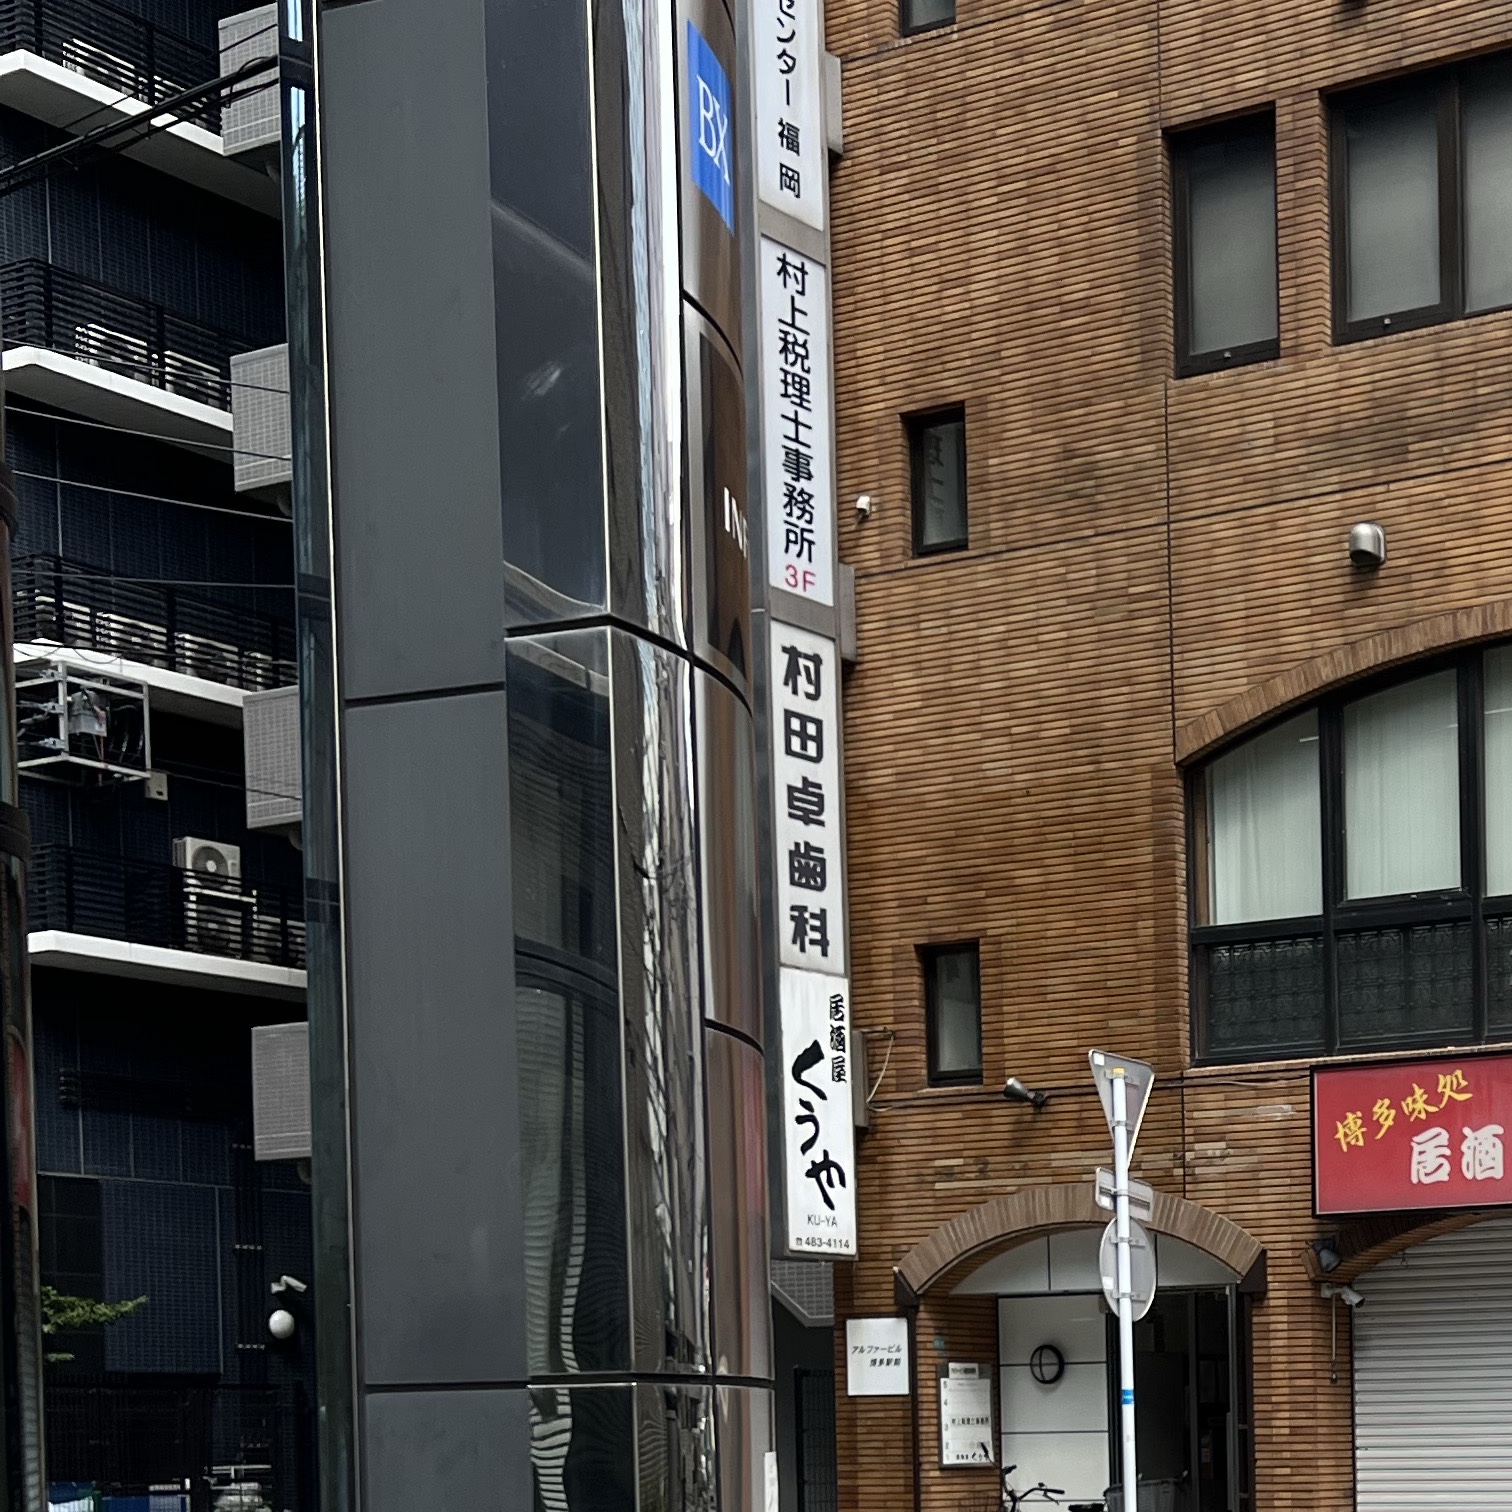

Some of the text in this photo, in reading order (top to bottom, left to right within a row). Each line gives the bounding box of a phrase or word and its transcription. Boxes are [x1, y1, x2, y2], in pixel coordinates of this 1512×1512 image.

[696, 74, 730, 185] BX
[776, 252, 816, 563] 村上税理士事務所
[785, 564, 816, 592] 3F
[781, 645, 830, 958] 村田卓歯科
[792, 1040, 847, 1210] くうや
[1334, 1068, 1474, 1153] 博多味処
[807, 1214, 838, 1227] KU-YA
